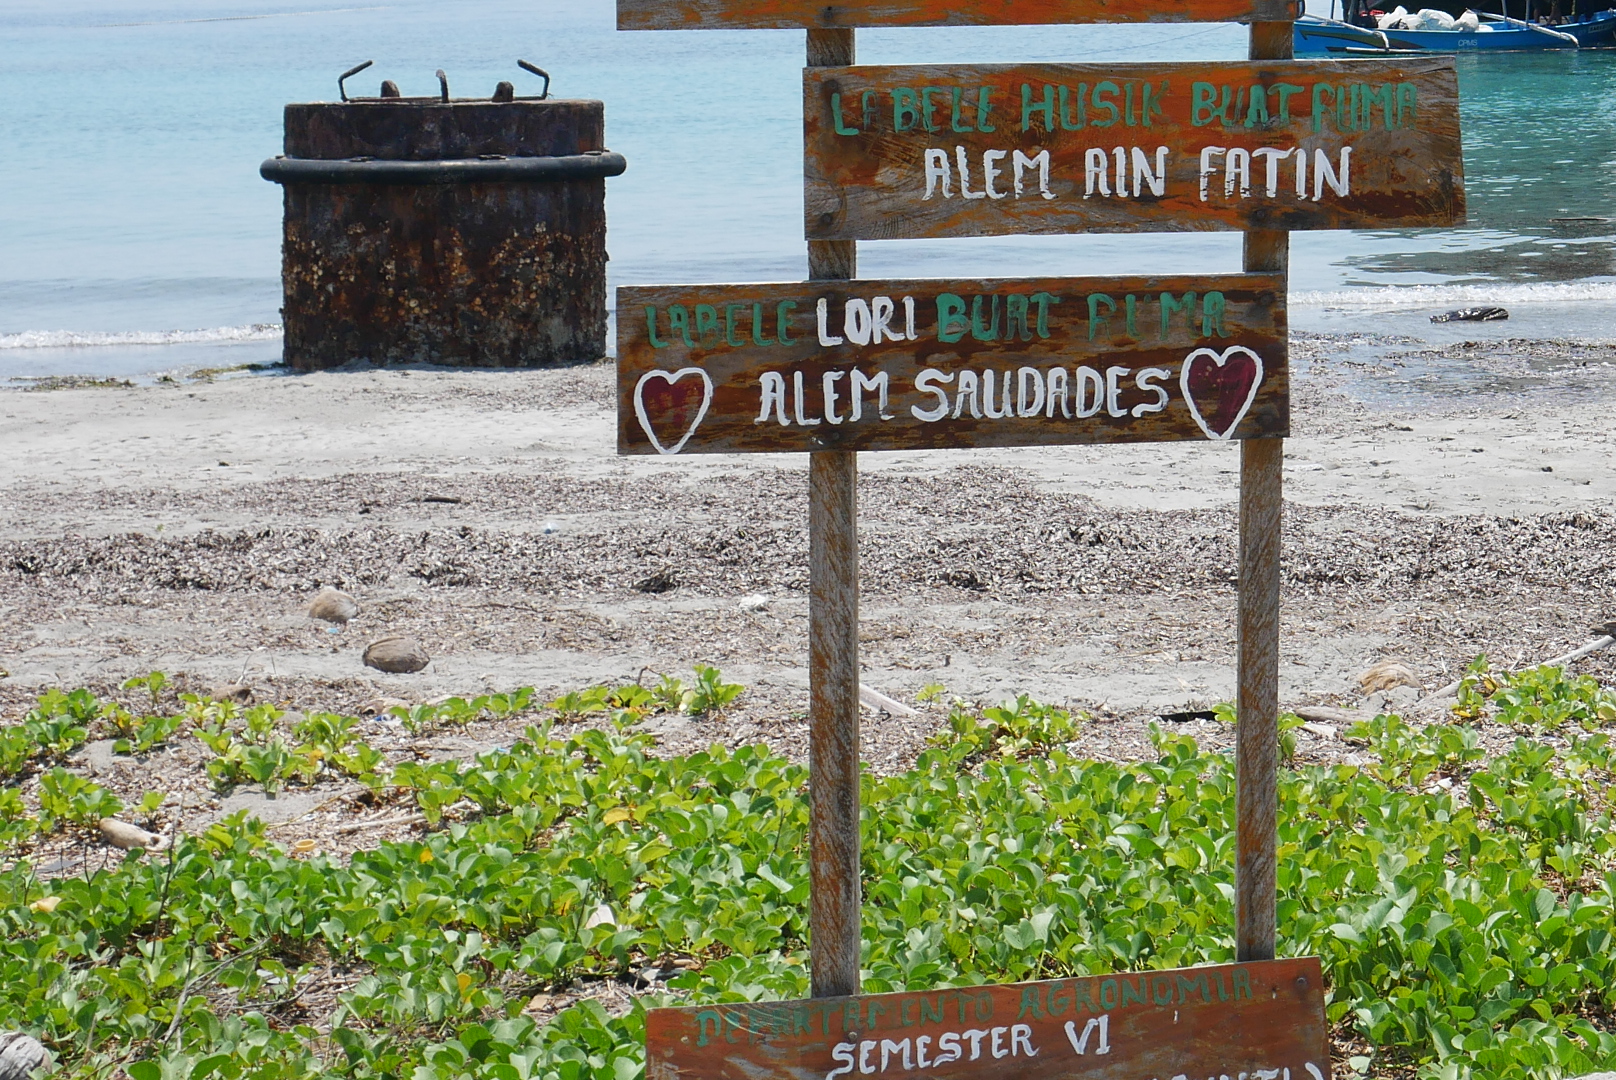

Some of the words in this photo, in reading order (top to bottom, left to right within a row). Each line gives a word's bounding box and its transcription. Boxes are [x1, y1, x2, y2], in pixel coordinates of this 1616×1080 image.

[831, 86, 996, 136] LABELE
[1191, 82, 1304, 129] BUAT
[921, 145, 1058, 200] ALEM
[1083, 146, 1170, 200] AIN
[1199, 146, 1353, 202] FATIN
[644, 300, 797, 349] LABELE
[816, 296, 919, 347] LORI
[935, 293, 1064, 342] BUAT
[754, 366, 896, 426] ALEM
[910, 366, 1172, 422] SAUDADES
[1016, 967, 1253, 1021] AGRONOMIA
[827, 1023, 1040, 1077] SEMESTER
[1064, 1014, 1111, 1055] VI
